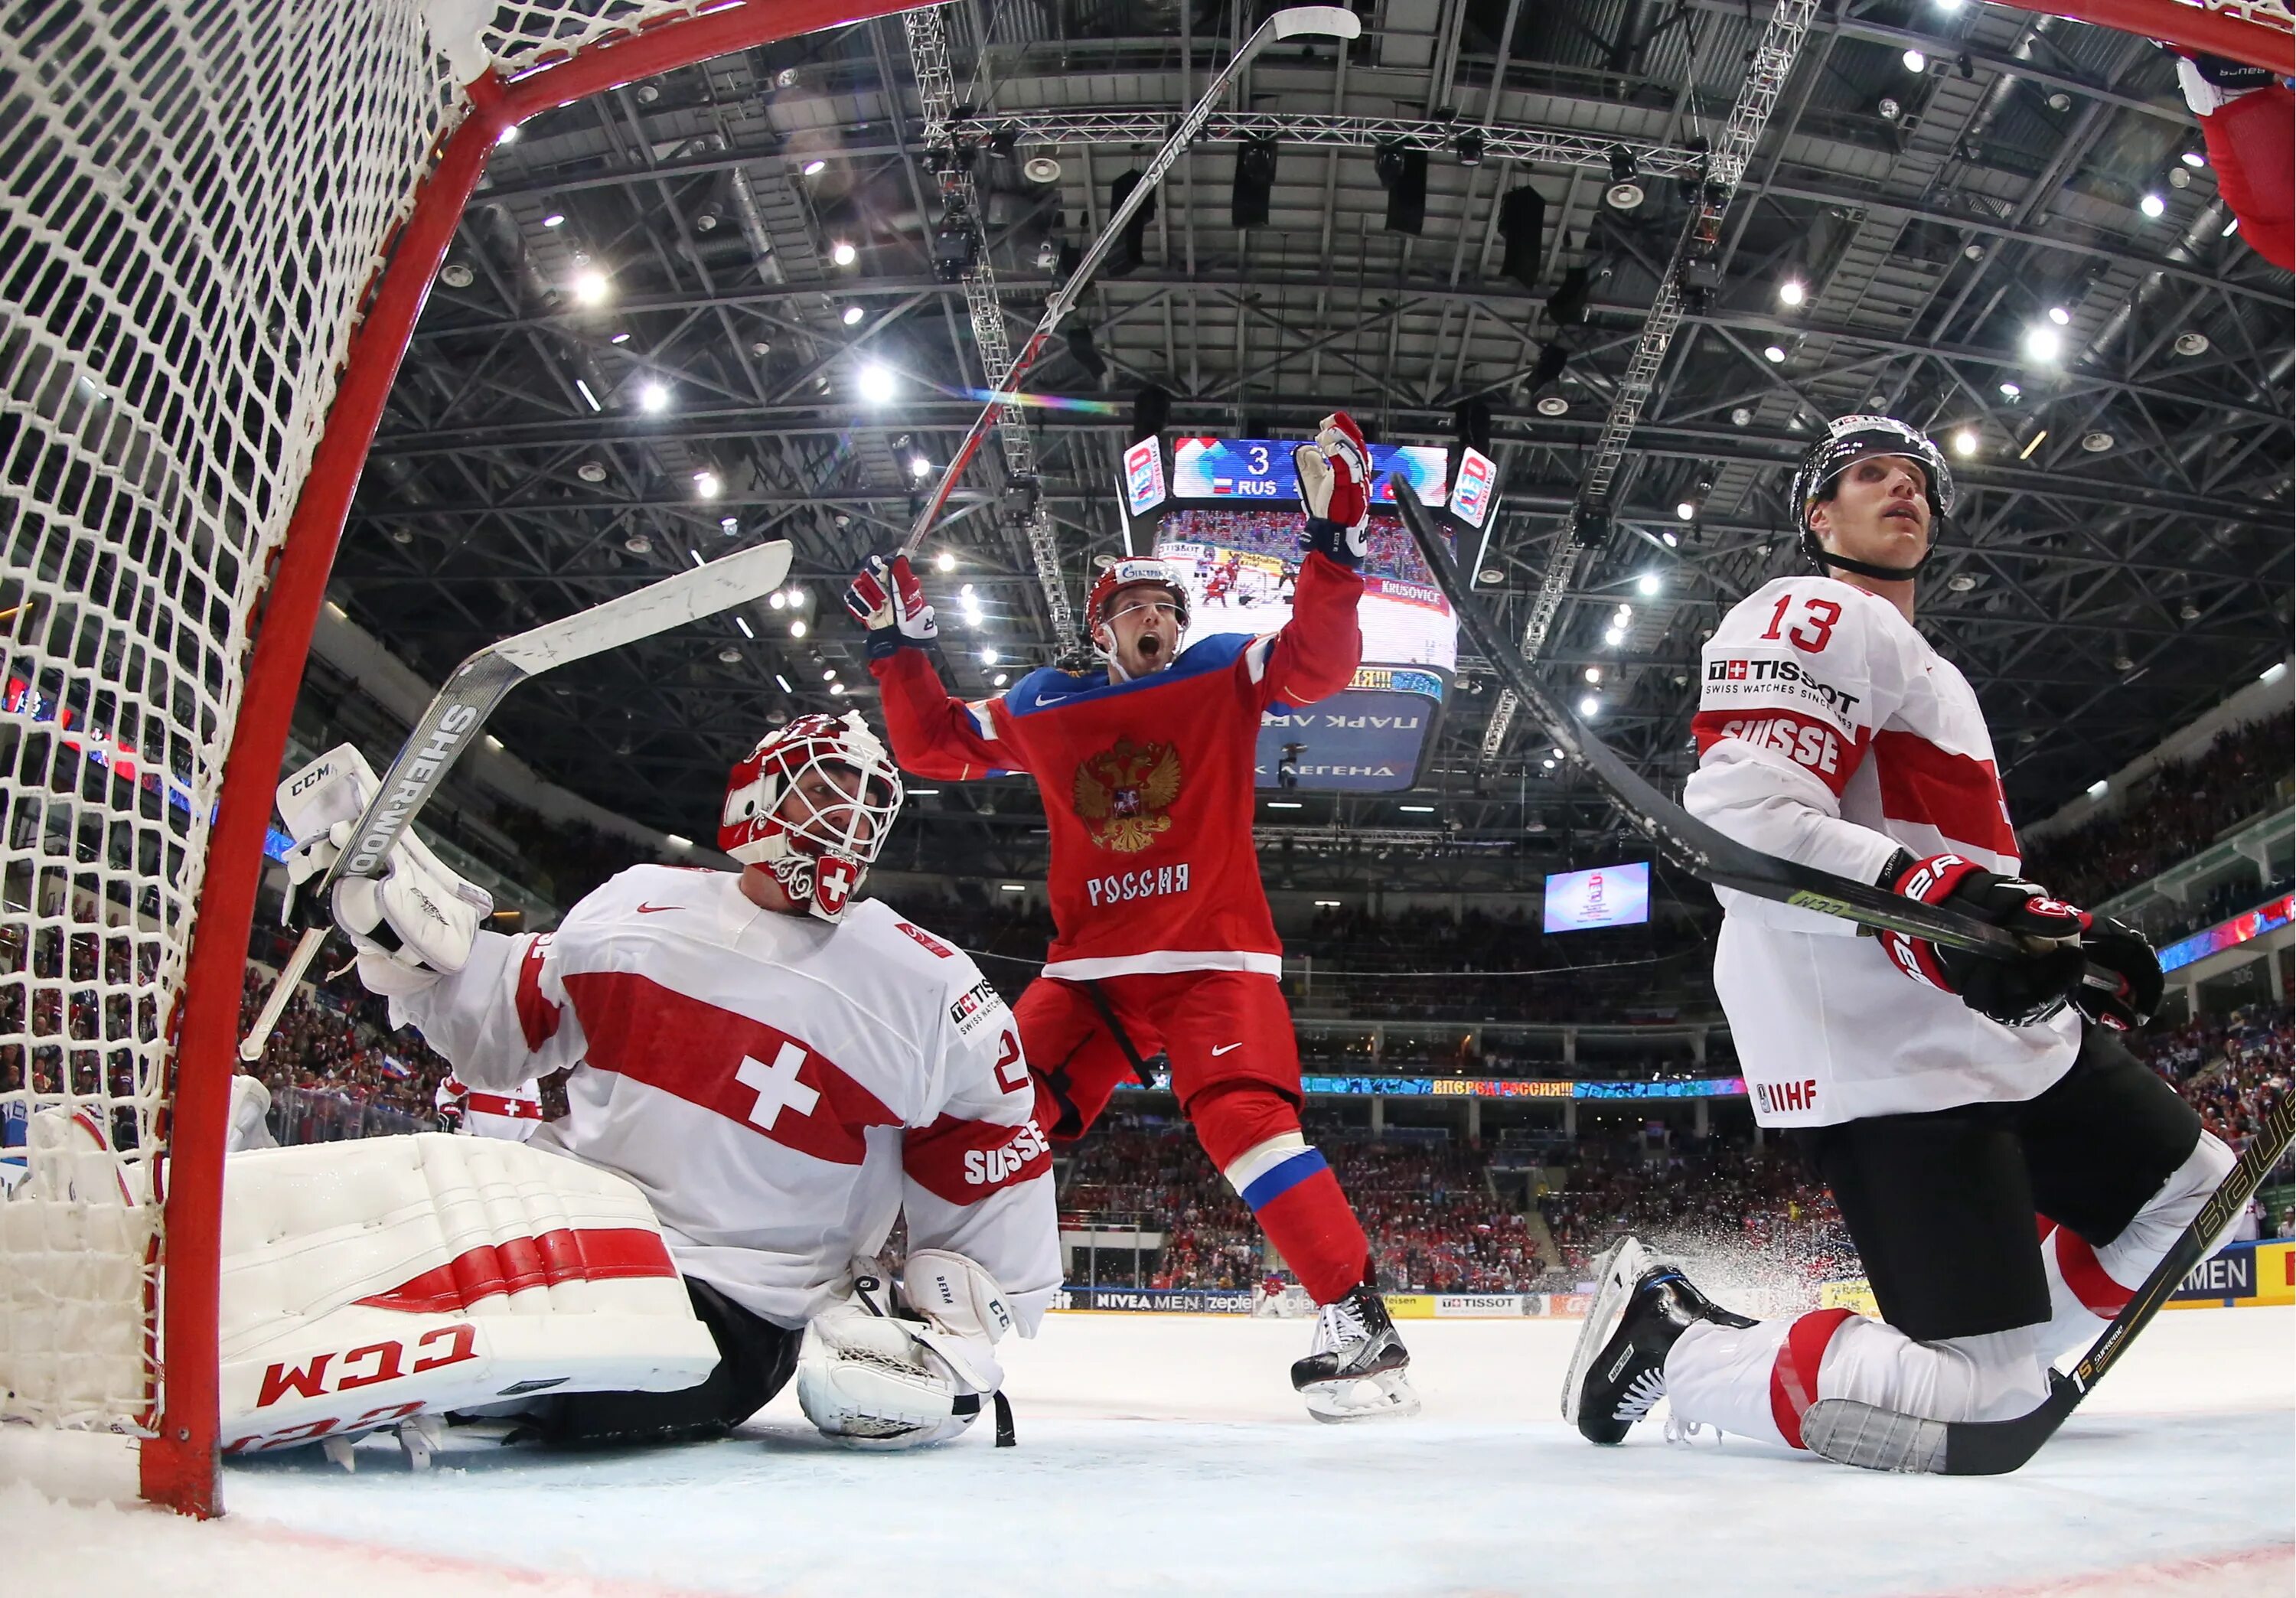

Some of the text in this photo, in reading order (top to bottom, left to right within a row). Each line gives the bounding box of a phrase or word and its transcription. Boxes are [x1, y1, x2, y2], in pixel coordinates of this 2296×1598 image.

[1150, 103, 1208, 184] BAUER
[1248, 448, 1269, 475] 3
[1238, 480, 1276, 495] RUS
[1382, 581, 1440, 604] KRUSOVICE
[1760, 594, 1842, 654] 13
[1706, 685, 1738, 694] SWISS
[1743, 684, 1795, 694] WATCHES
[1751, 660, 1860, 714] TISSOT
[1326, 715, 1419, 729] ПАРК
[1720, 719, 1838, 775] SUISSE
[291, 762, 330, 797] CCM
[1087, 863, 1189, 906] РОССИЯ
[1794, 896, 1844, 915] CCM
[960, 1014, 983, 1035] SWISS
[1769, 1079, 1816, 1111] IIHF
[964, 1120, 1051, 1185] SUISSE
[937, 1276, 954, 1304] BERRA
[2189, 1258, 2247, 1290] MEN
[989, 1298, 1010, 1330] CC
[1097, 1293, 1199, 1309] NIVEA MEN
[1463, 1298, 1513, 1307] TISSOT
[2093, 1325, 2124, 1364] SUPREME
[256, 1323, 479, 1407] CCM
[1610, 1348, 1632, 1380] BAUER
